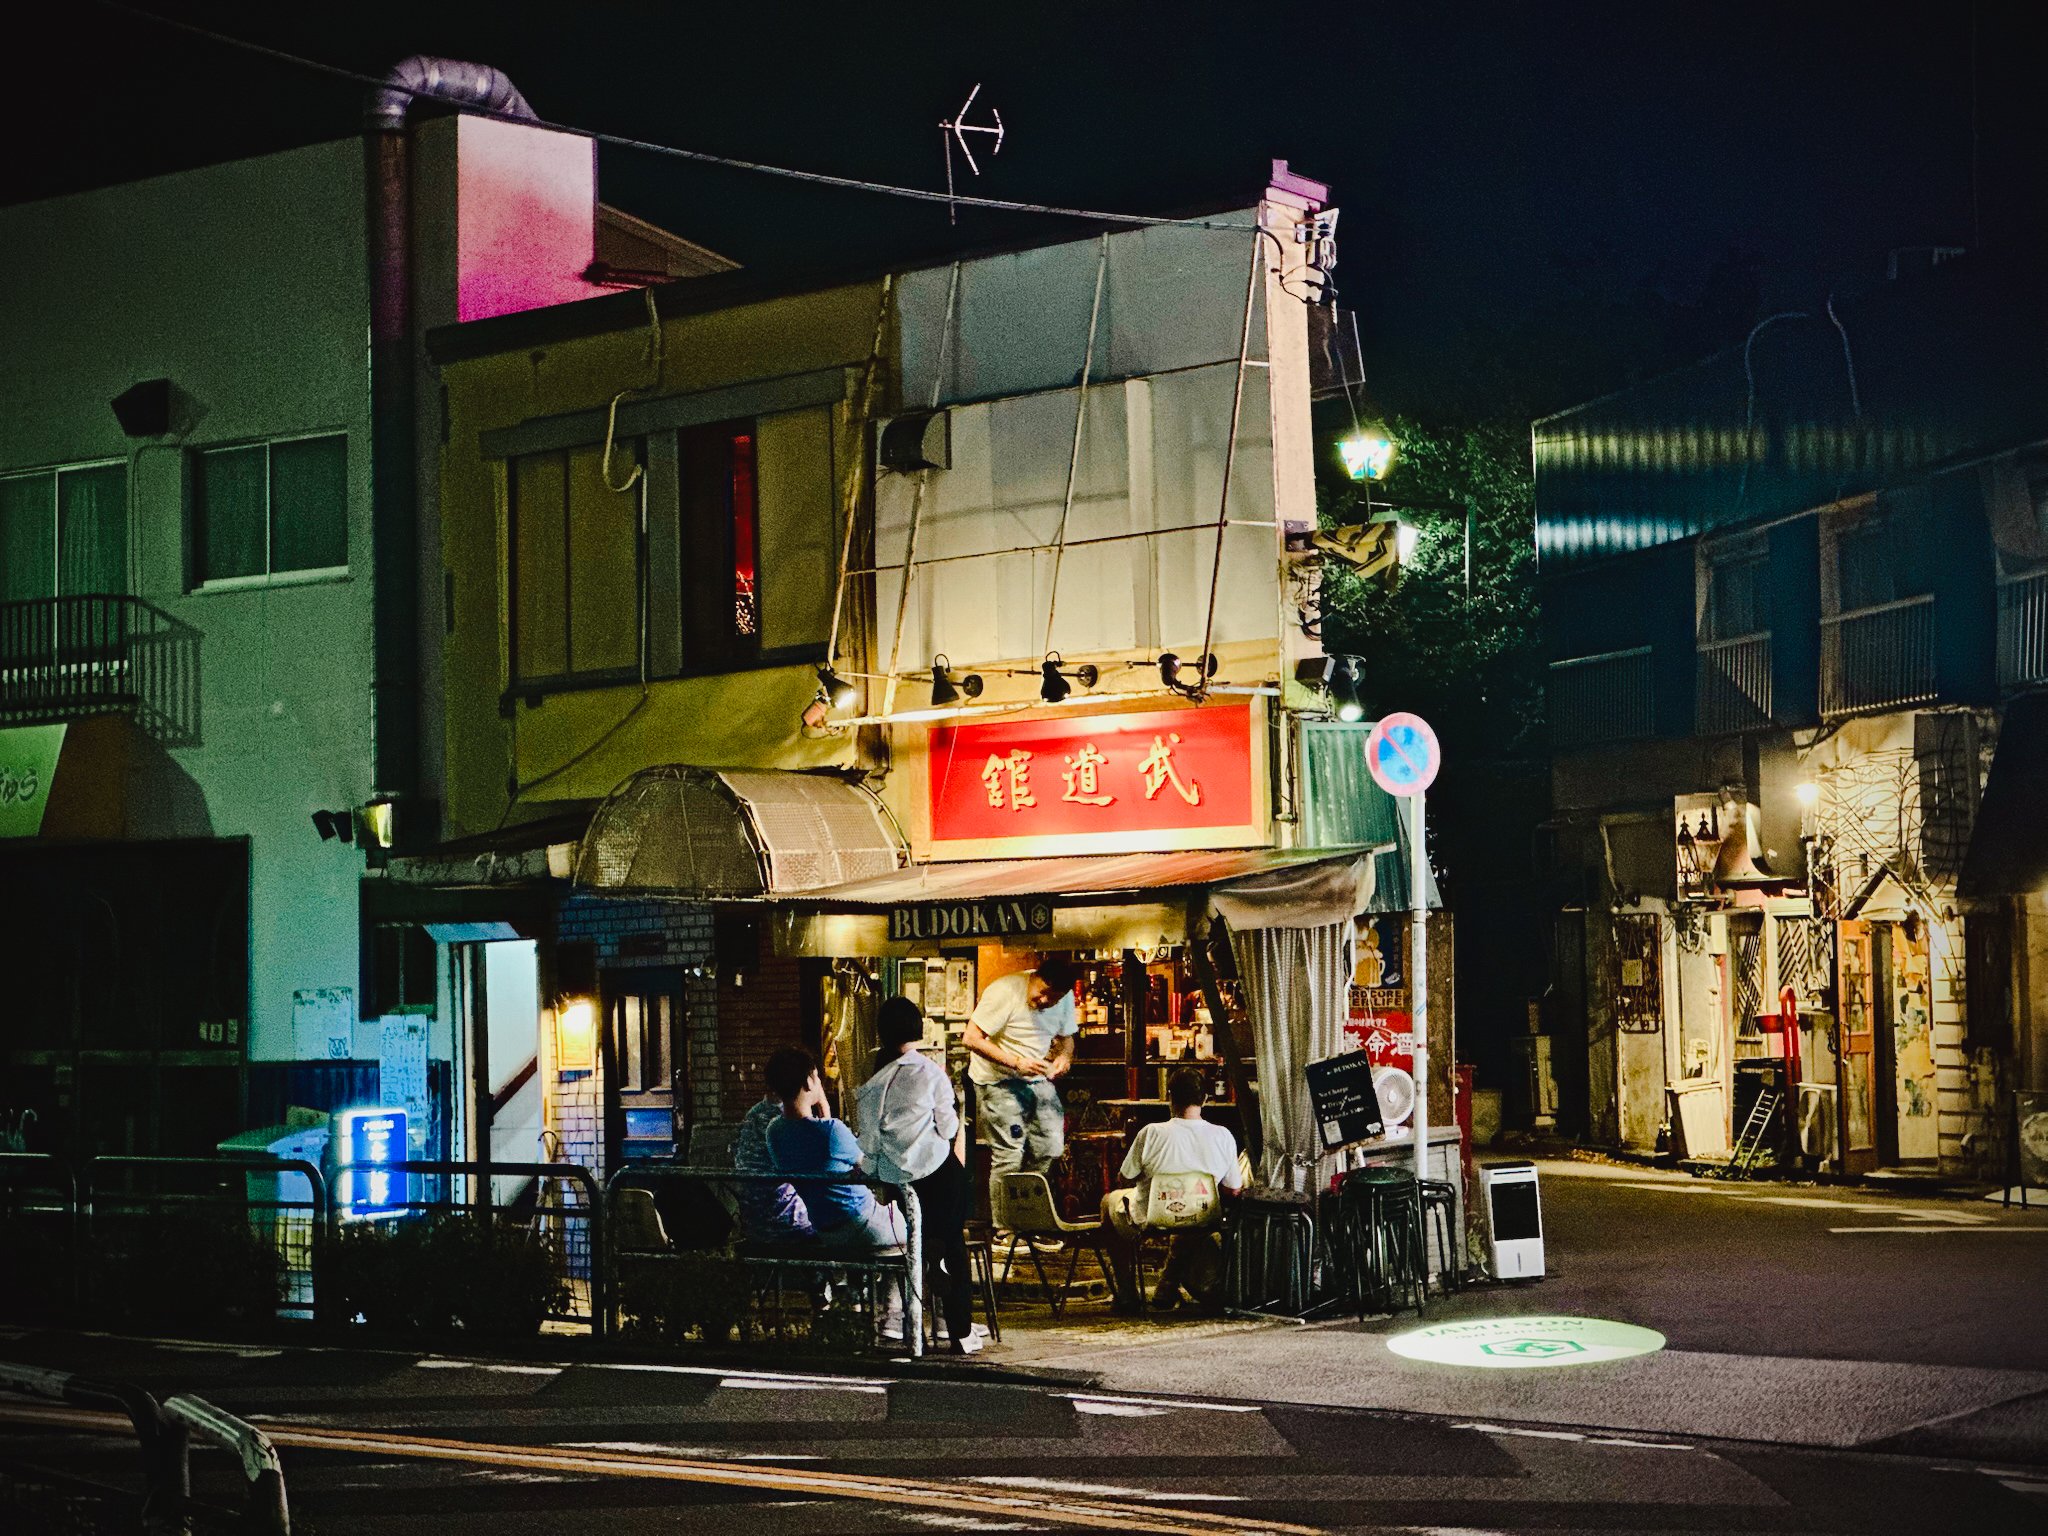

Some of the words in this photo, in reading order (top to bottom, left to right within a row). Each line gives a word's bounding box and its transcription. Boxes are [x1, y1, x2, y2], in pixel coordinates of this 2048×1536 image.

[982, 733, 1200, 811] 武道館
[894, 902, 1027, 938] BUDOKAN
[1349, 998, 1370, 1006] ER
[1374, 998, 1402, 1006] LIFE
[1370, 990, 1402, 998] CORE
[1333, 1060, 1367, 1074] BUDOKAN
[1422, 1319, 1585, 1338] JAMESON
